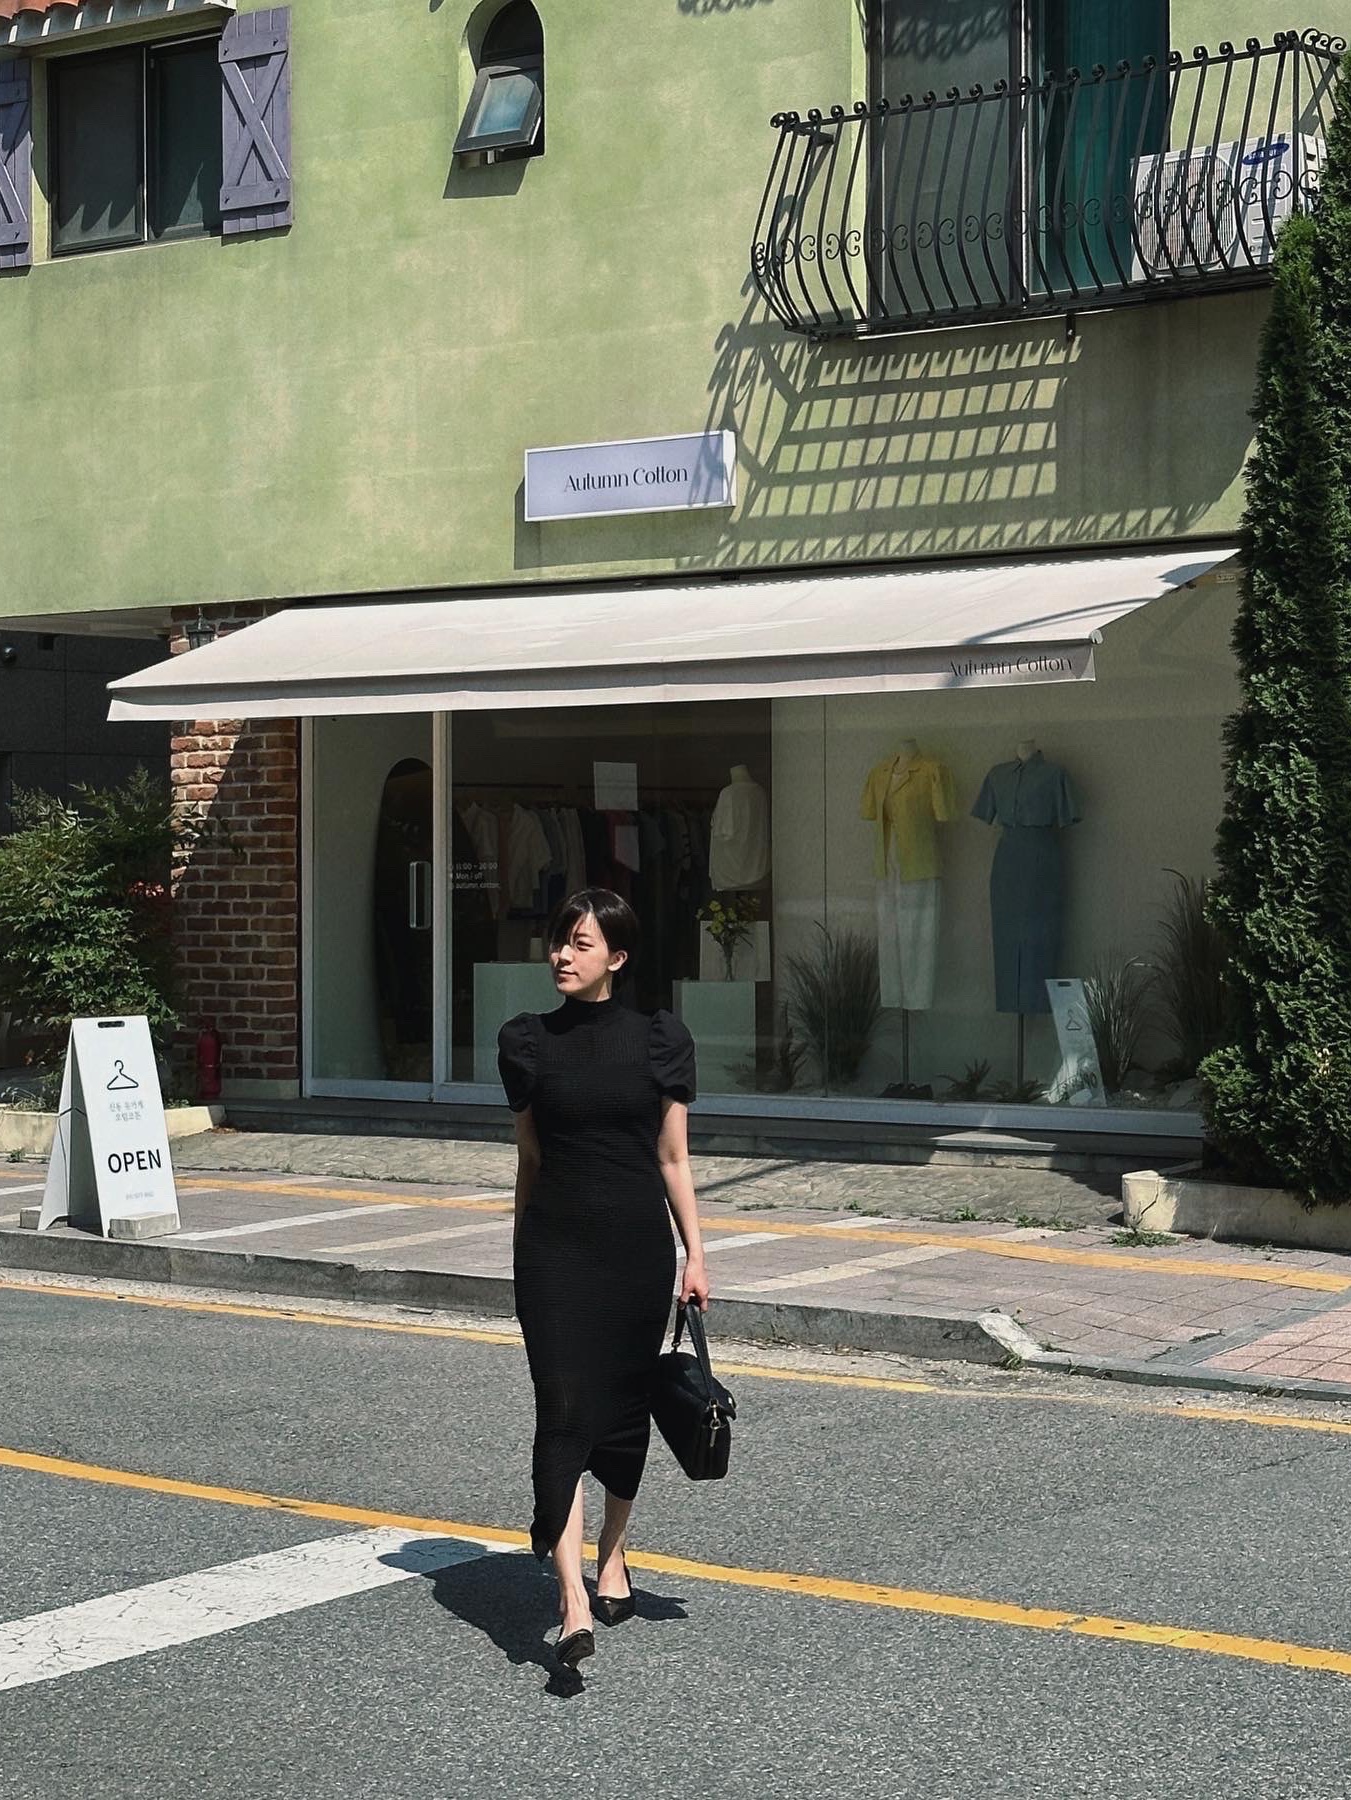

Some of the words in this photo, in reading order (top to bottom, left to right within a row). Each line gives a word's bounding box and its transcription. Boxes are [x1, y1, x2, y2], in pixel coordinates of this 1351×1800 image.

[564, 473, 629, 492] Autumn
[633, 466, 688, 486] Cotton
[950, 660, 1012, 677] Autumn
[1016, 655, 1073, 674] Cotton
[108, 1148, 162, 1174] OPEN
